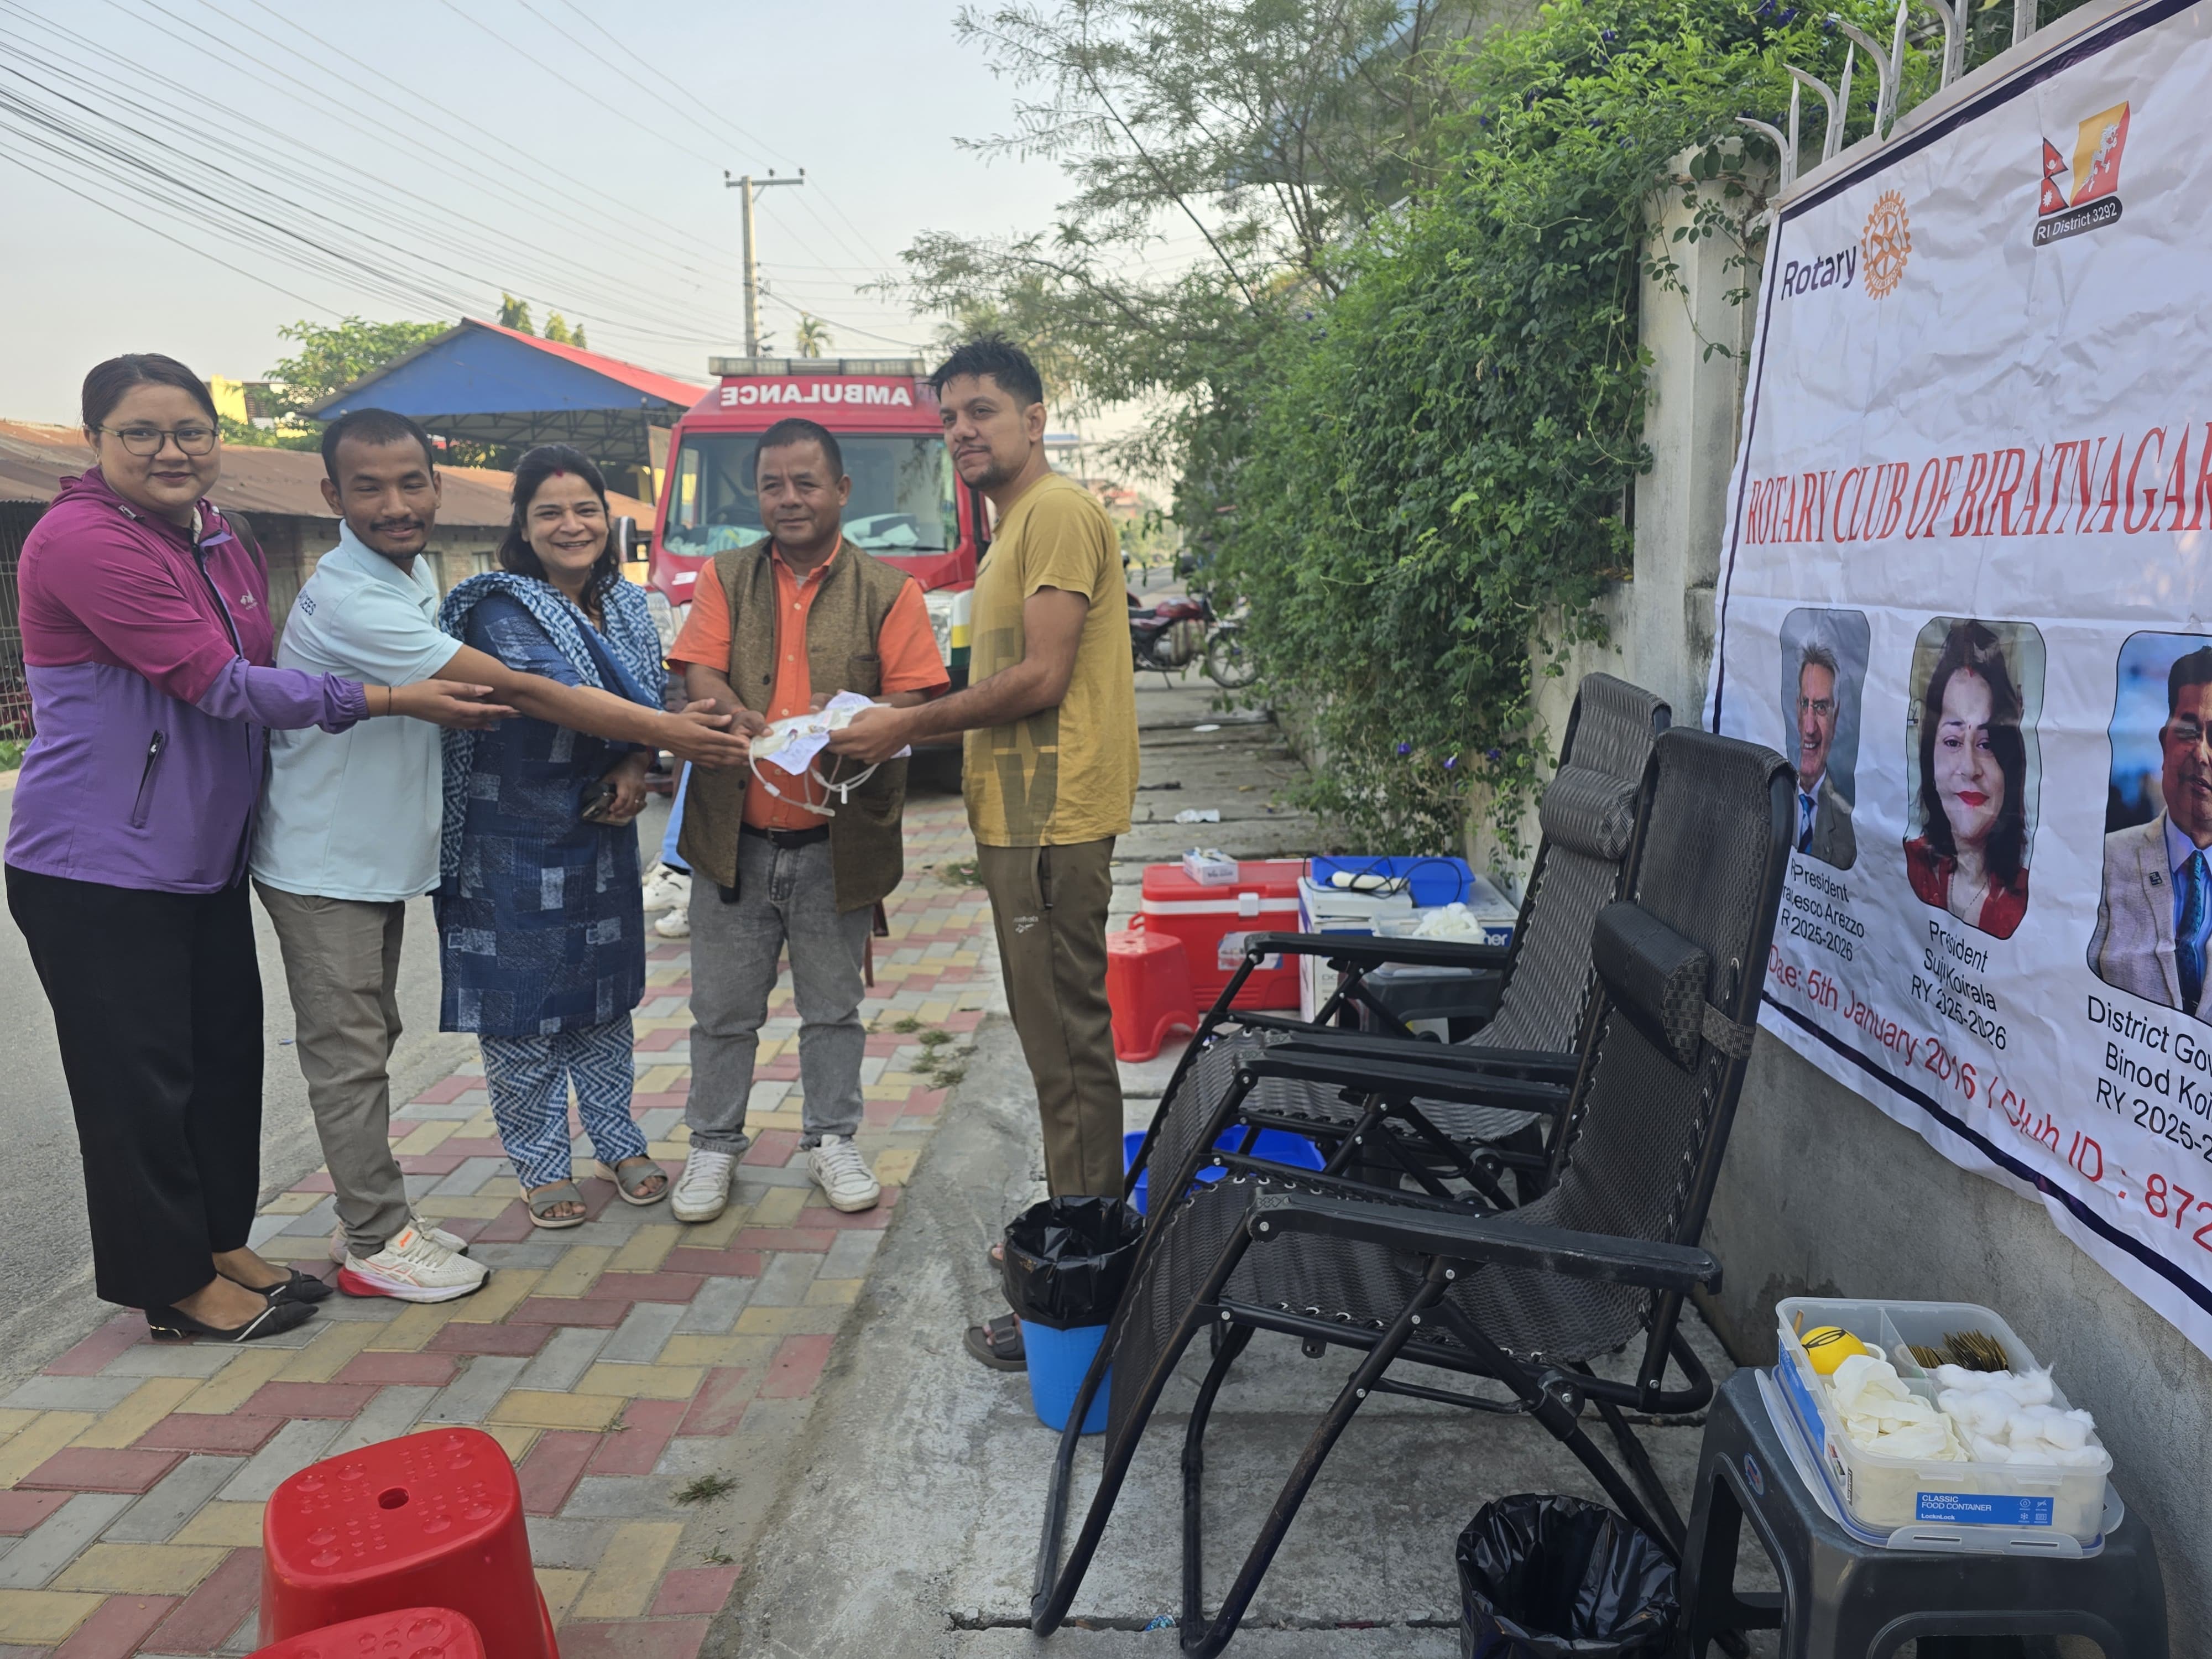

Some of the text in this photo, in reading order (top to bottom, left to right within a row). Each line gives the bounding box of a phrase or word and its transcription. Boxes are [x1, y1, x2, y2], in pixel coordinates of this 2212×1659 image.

[2037, 202, 2117, 241] RI District 3292
[1781, 246, 1856, 301] Rotary
[1745, 470, 1837, 545] ROTARY
[1833, 462, 1910, 543] CLUB
[1905, 455, 1964, 540] OF
[1793, 864, 1849, 902] President
[1791, 916, 1853, 962] 2025-2026
[1825, 904, 1865, 938] Arezzo
[1929, 920, 1988, 973] President
[1911, 974, 1933, 1003] RY
[2088, 994, 2169, 1053] District
[1808, 969, 1838, 1011] 5th
[1843, 990, 1919, 1066] January
[1924, 1037, 1977, 1100] 2016
[2068, 1131, 2104, 1182] ID
[2106, 1041, 2170, 1097] Binod
[2096, 1077, 2126, 1115] RY
[1922, 1494, 1959, 1503] CLASSIC
[1922, 1501, 1992, 1511] FOOD CONTAINER
